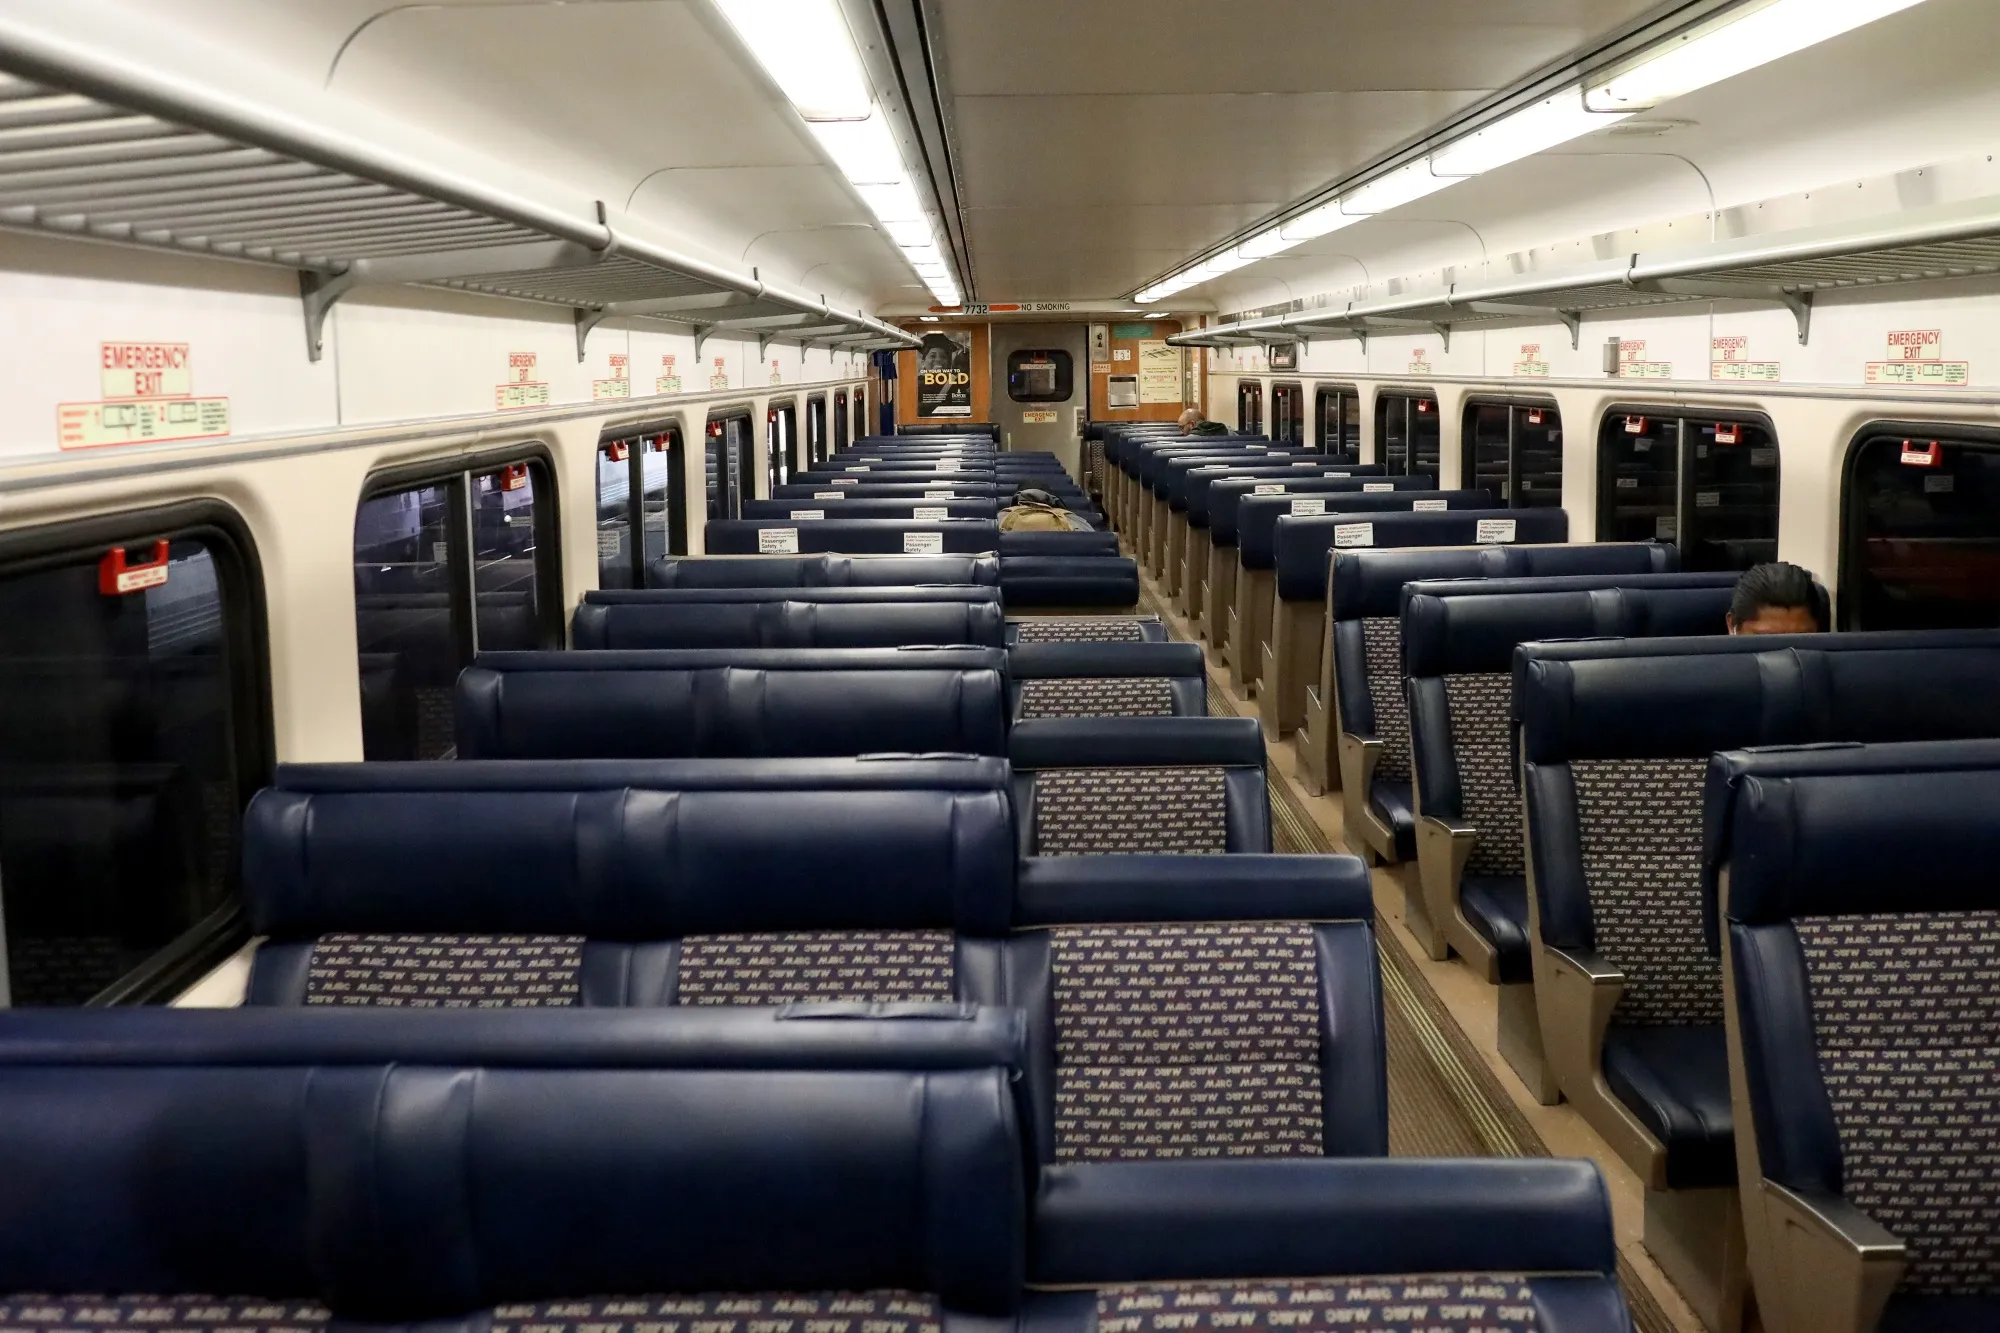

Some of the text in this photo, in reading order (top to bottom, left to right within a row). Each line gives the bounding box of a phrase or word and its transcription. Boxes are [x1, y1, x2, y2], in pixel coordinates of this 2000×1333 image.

[964, 304, 988, 314] 7732
[1021, 302, 1070, 311] NO SMOKING
[1712, 338, 1746, 349] EMERGENCY
[1888, 332, 1940, 346] EMERGENCY
[1620, 342, 1645, 351] EMERGENCY
[1904, 346, 1922, 359] EXIT
[103, 345, 188, 369] EMERGENCY
[510, 354, 536, 367] EMERGENCY
[1724, 350, 1735, 360] EXIT
[135, 371, 163, 395] EXIT
[925, 373, 969, 385] BOLD
[1058, 952, 1084, 960] MARC
[1092, 952, 1119, 960] MARC
[1161, 950, 1188, 959] MARC
[1197, 950, 1224, 958] MARC
[1232, 949, 1258, 957] MARC
[1266, 949, 1294, 957] MARC
[1059, 974, 1296, 986] MARC MARC MARC MARC MARC MARC MARC
[1063, 1078, 1320, 1090] MARC MARC MARC MARC MARC MARC MARC
